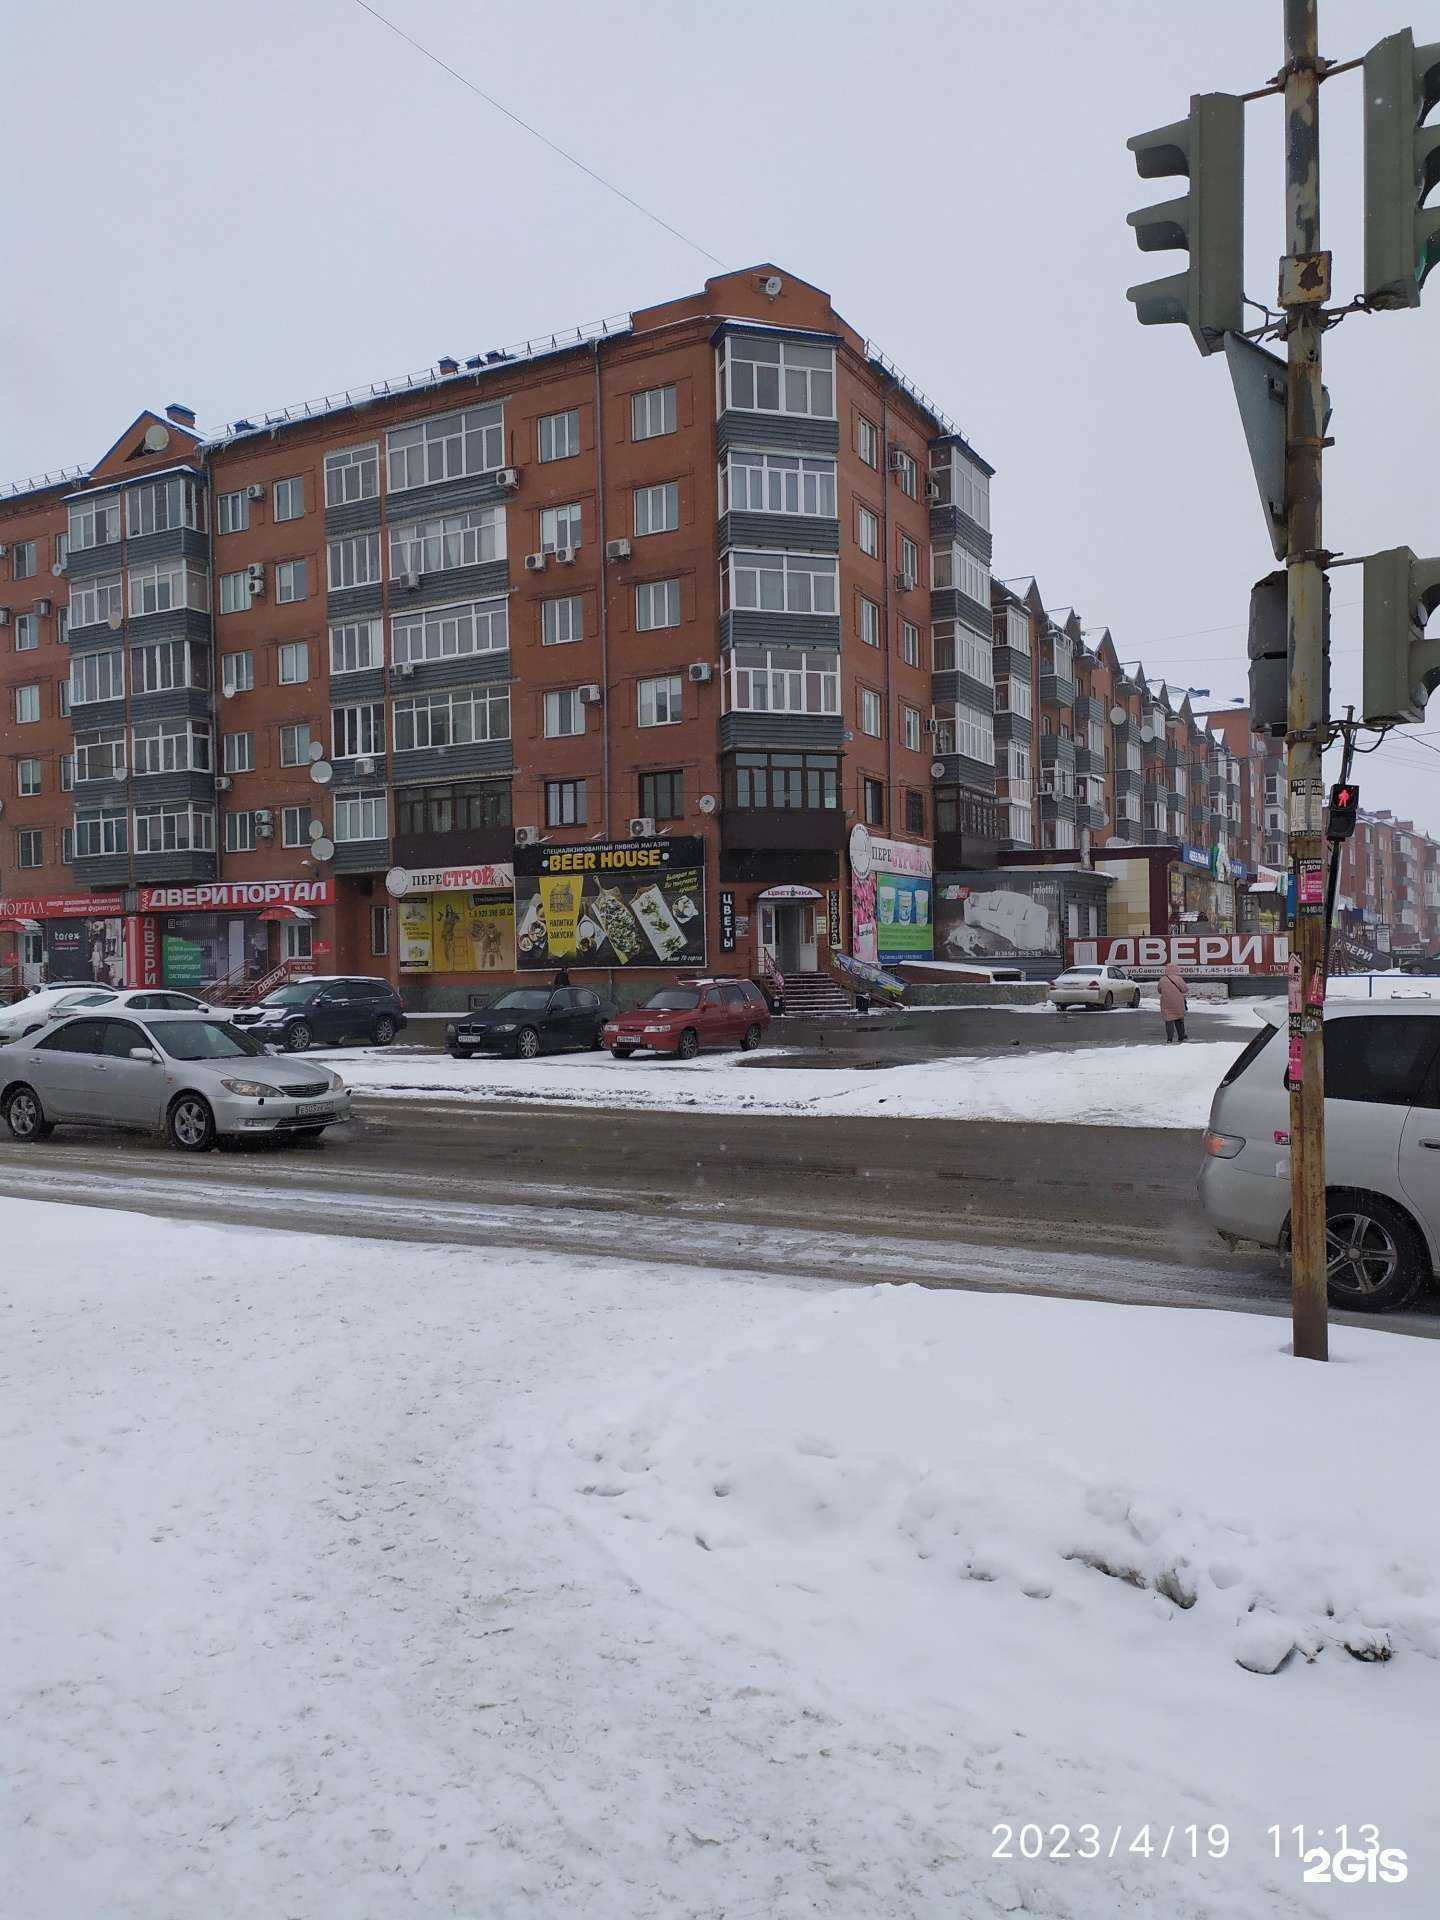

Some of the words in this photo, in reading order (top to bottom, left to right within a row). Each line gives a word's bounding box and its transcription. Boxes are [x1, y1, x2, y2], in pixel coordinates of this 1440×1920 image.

[614, 843, 640, 851] ПИВНОЙ
[641, 841, 670, 849] МАГАЗИН
[549, 853, 596, 872] BEER
[600, 850, 662, 869] HOUSE
[411, 865, 505, 888] ПЕРЕСТРОЙКА
[149, 886, 229, 907] ДВЕРИ
[232, 881, 327, 904] ПОРТАЛ
[0, 901, 45, 916] ПОРТАЛ
[550, 918, 574, 927] НАПИТКИ
[722, 893, 734, 949] ЦВЕТЫ
[55, 931, 80, 941] torex
[550, 930, 574, 940] ЗАКУСКИ
[143, 917, 157, 985] ДВЕРИ
[1104, 935, 1263, 966] ДВЕРИ
[257, 966, 288, 995] ДВЕРИ
